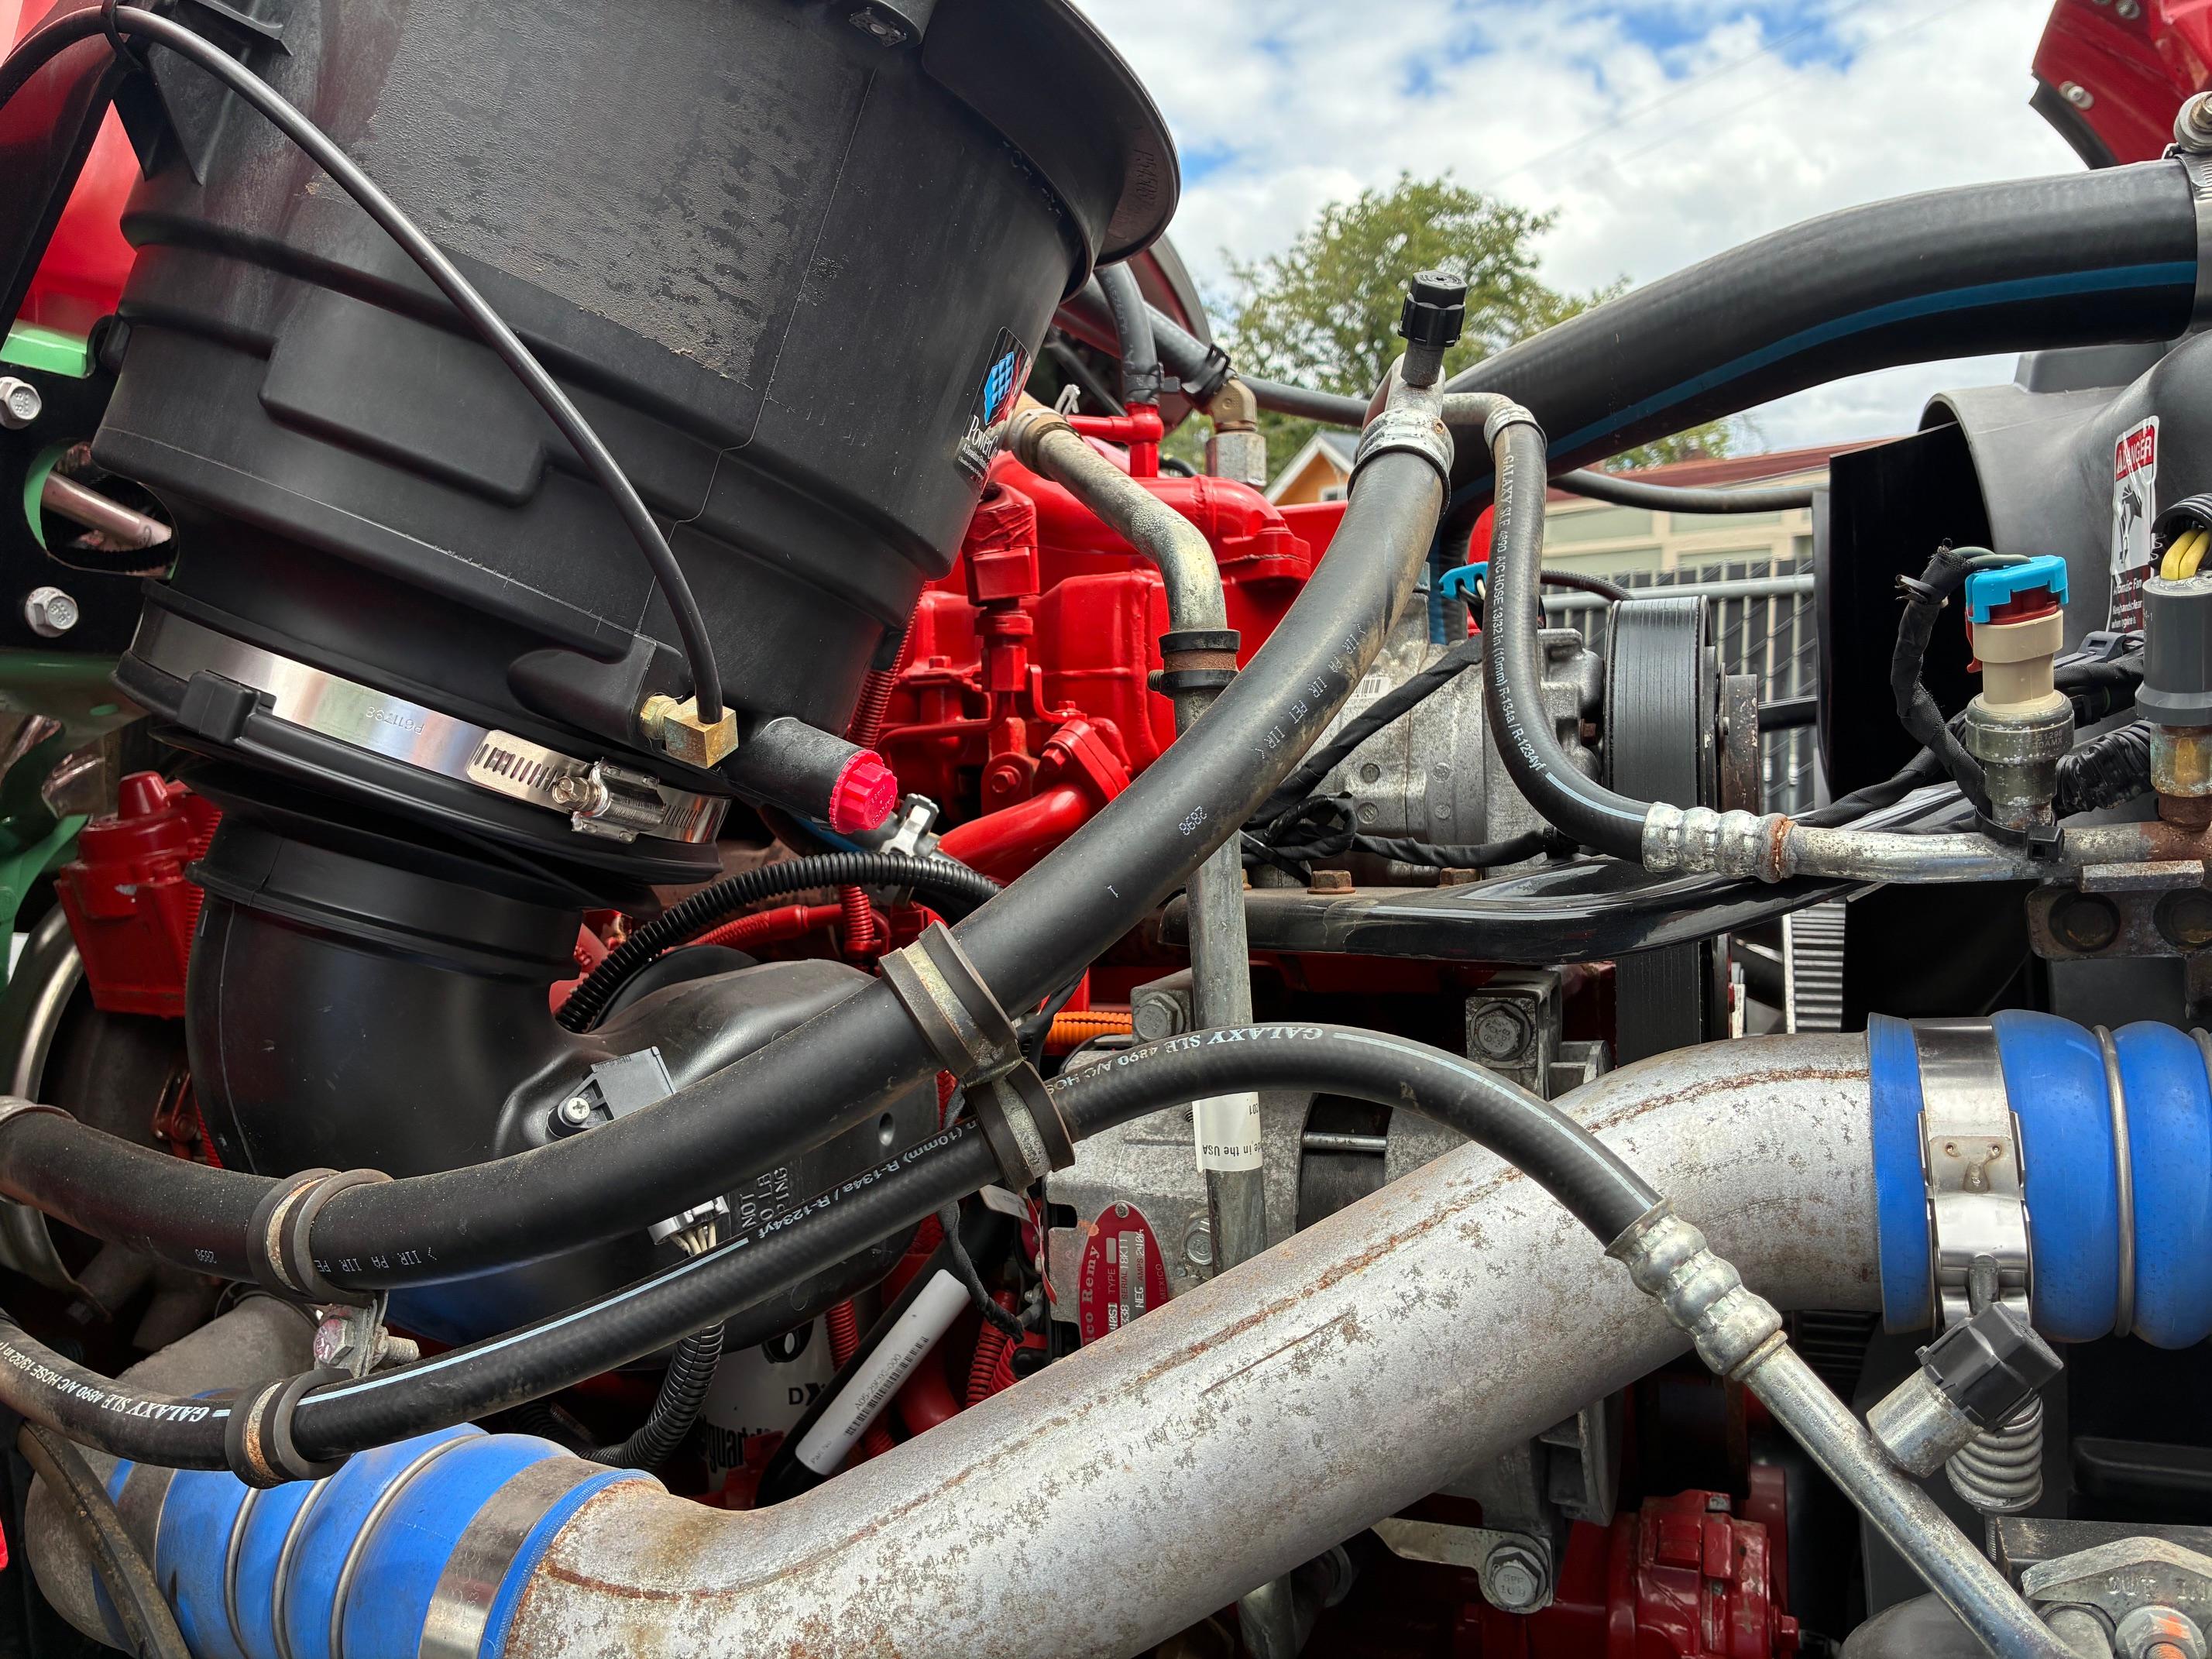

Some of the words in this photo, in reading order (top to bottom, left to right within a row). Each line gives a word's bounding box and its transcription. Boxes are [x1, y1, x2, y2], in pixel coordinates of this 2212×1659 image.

[1499, 455, 1514, 504] GALAXY
[1498, 507, 1512, 528] SLE
[1492, 576, 1505, 606] HOSE
[1492, 607, 1504, 634] 13/32
[1492, 634, 1503, 647] in
[1492, 647, 1509, 687] (10mm)
[1499, 686, 1515, 725] R-134a
[1511, 727, 1547, 771] R-1234yf
[1164, 1034, 1200, 1053] SLE
[1207, 1026, 1323, 1046] GALAXY
[1118, 1046, 1158, 1066] 4890
[1084, 1060, 1111, 1079] A/C
[1047, 1075, 1081, 1095] HOS
[903, 1127, 963, 1163] (10mm)
[1203, 1145, 1220, 1156] USA
[1224, 1146, 1239, 1156] the
[1243, 1145, 1252, 1155] in
[843, 1159, 900, 1193] R-134a
[757, 1195, 831, 1238] R-1234yf
[314, 1259, 331, 1273] PE
[1082, 1245, 1100, 1304] Remy
[1108, 1268, 1116, 1294] TYPE
[1155, 1263, 1167, 1300] MEXICO
[1134, 1286, 1145, 1308] NEG
[3, 1345, 15, 1359] in
[9, 1353, 36, 1372] 13/32
[29, 1364, 62, 1389] HOSE
[57, 1377, 80, 1395] A/C
[76, 1386, 105, 1404] 4890
[101, 1393, 132, 1413] SLE
[126, 1400, 211, 1423] GALAXY
